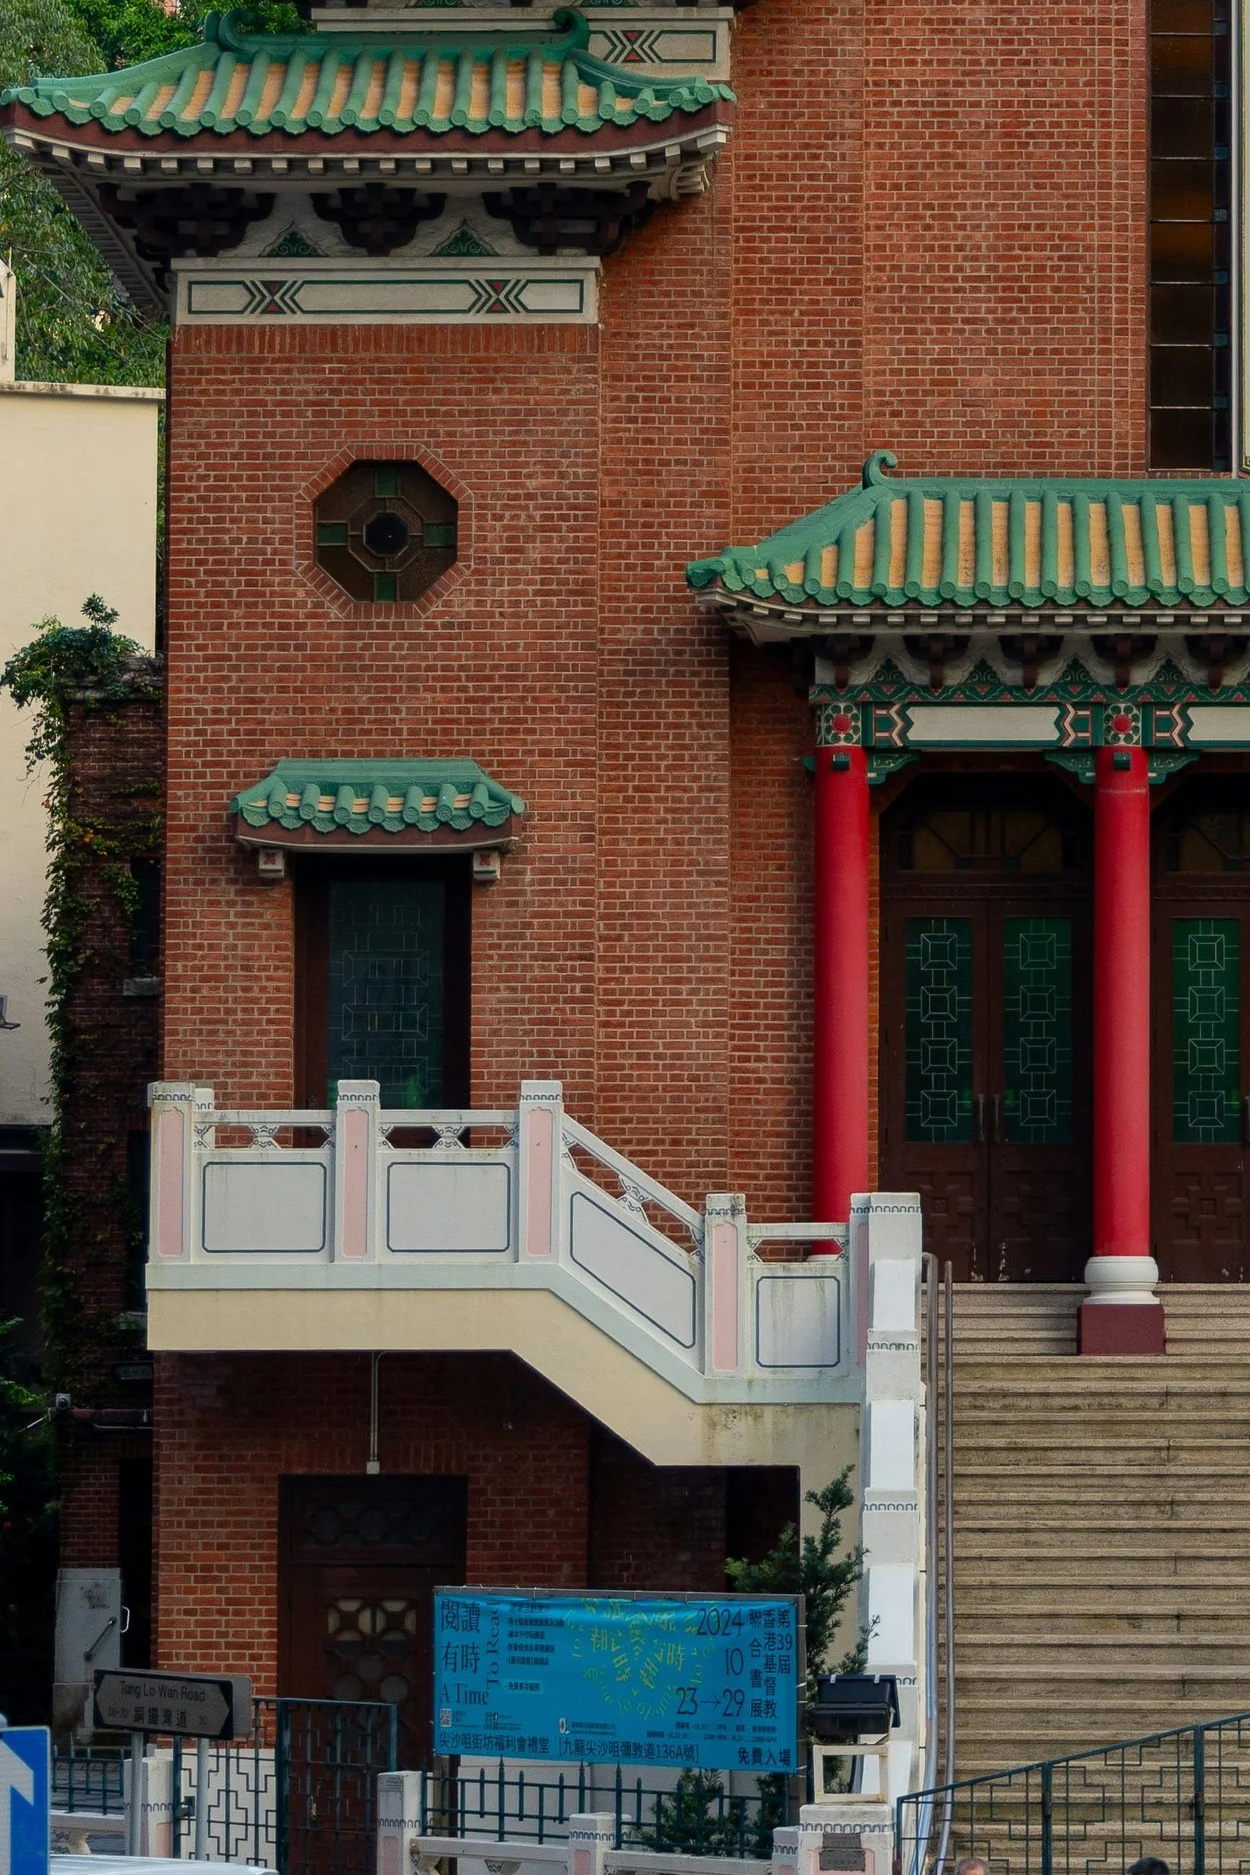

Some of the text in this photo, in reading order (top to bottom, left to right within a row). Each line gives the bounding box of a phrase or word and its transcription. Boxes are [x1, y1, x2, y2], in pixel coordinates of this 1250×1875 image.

[441, 1599, 481, 1634] 閱讀
[697, 1608, 745, 1637] 2024
[777, 1608, 793, 1675] 第39屆
[443, 1640, 481, 1675] 有時
[724, 1647, 745, 1677] 10
[748, 1608, 763, 1719] 聯合書展
[763, 1608, 778, 1720] 香港基督教
[486, 1661, 500, 1690] To
[119, 1680, 206, 1702] Tung Lo Wan Road
[440, 1683, 490, 1706] A Time
[675, 1687, 699, 1716] 23
[722, 1688, 746, 1717] 29
[133, 1706, 188, 1728] 銅鑼灣道
[439, 1732, 550, 1755] 尖沙咀街坊福利會禮堂
[737, 1747, 792, 1767] 免費入場
